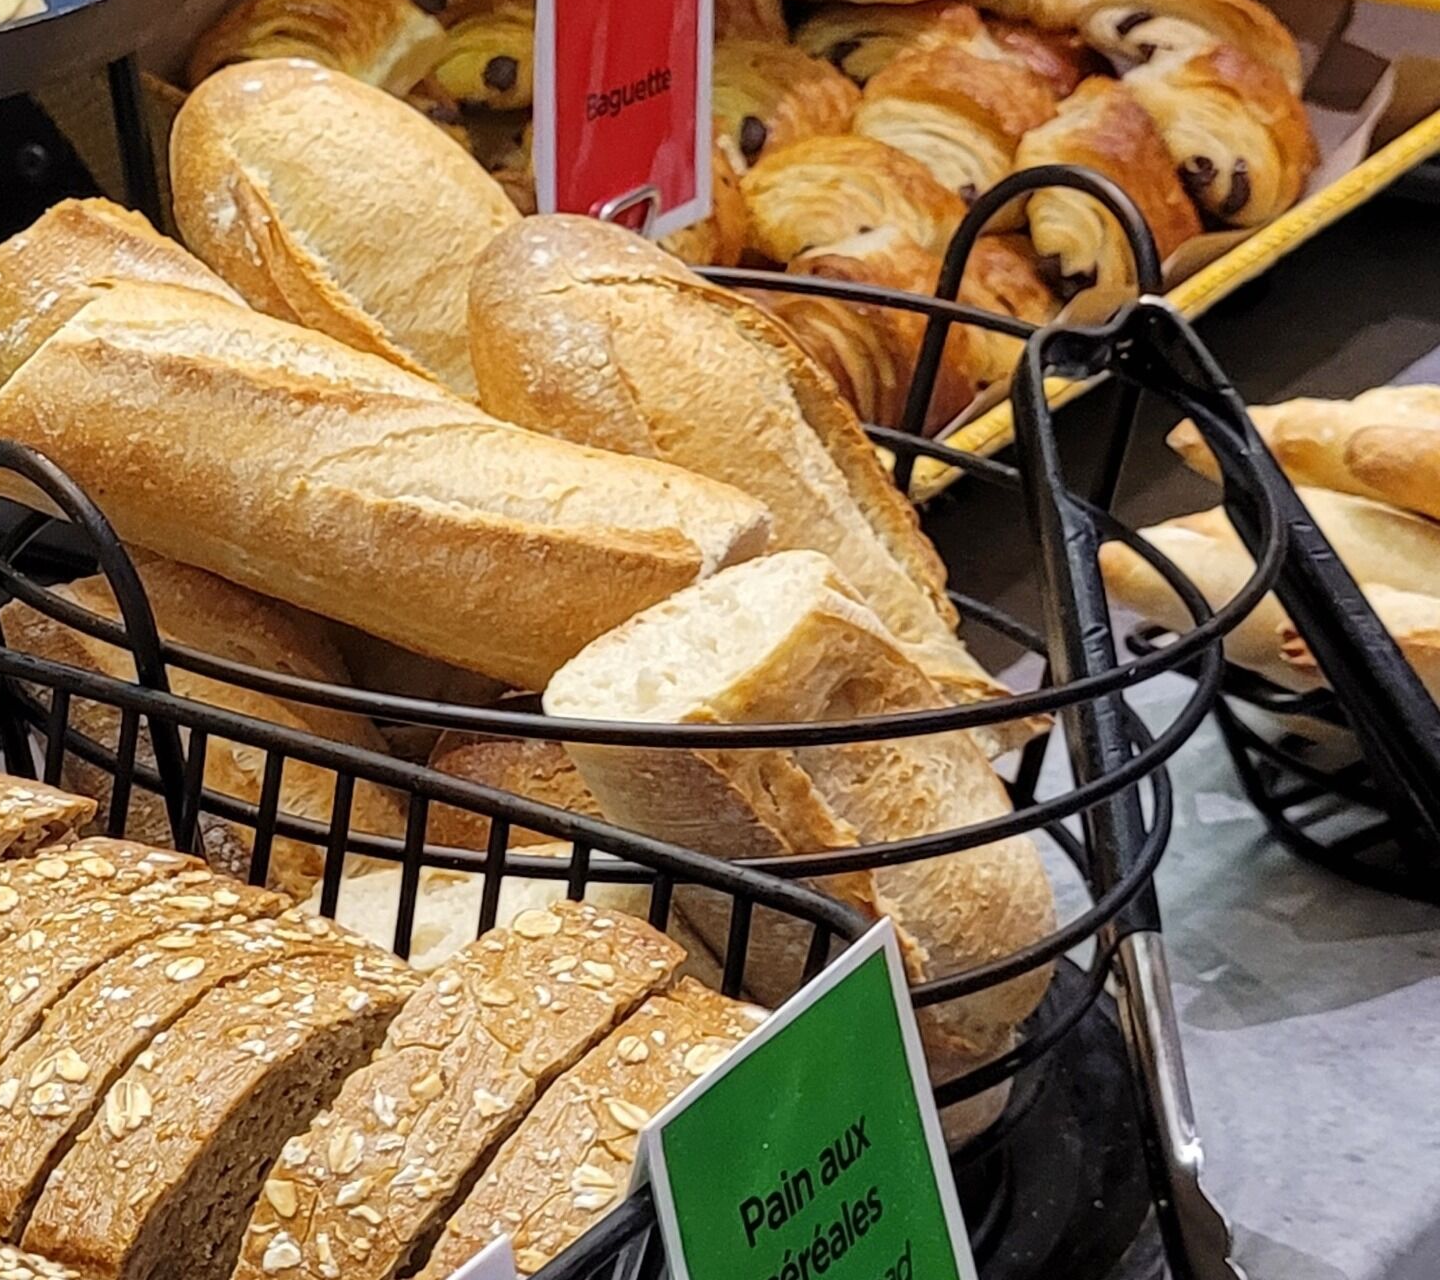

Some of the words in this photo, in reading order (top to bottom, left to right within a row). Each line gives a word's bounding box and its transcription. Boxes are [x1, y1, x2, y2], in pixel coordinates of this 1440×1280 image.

[586, 67, 672, 121] Baguette
[739, 1166, 815, 1249] Pain
[819, 1115, 872, 1189] aux
